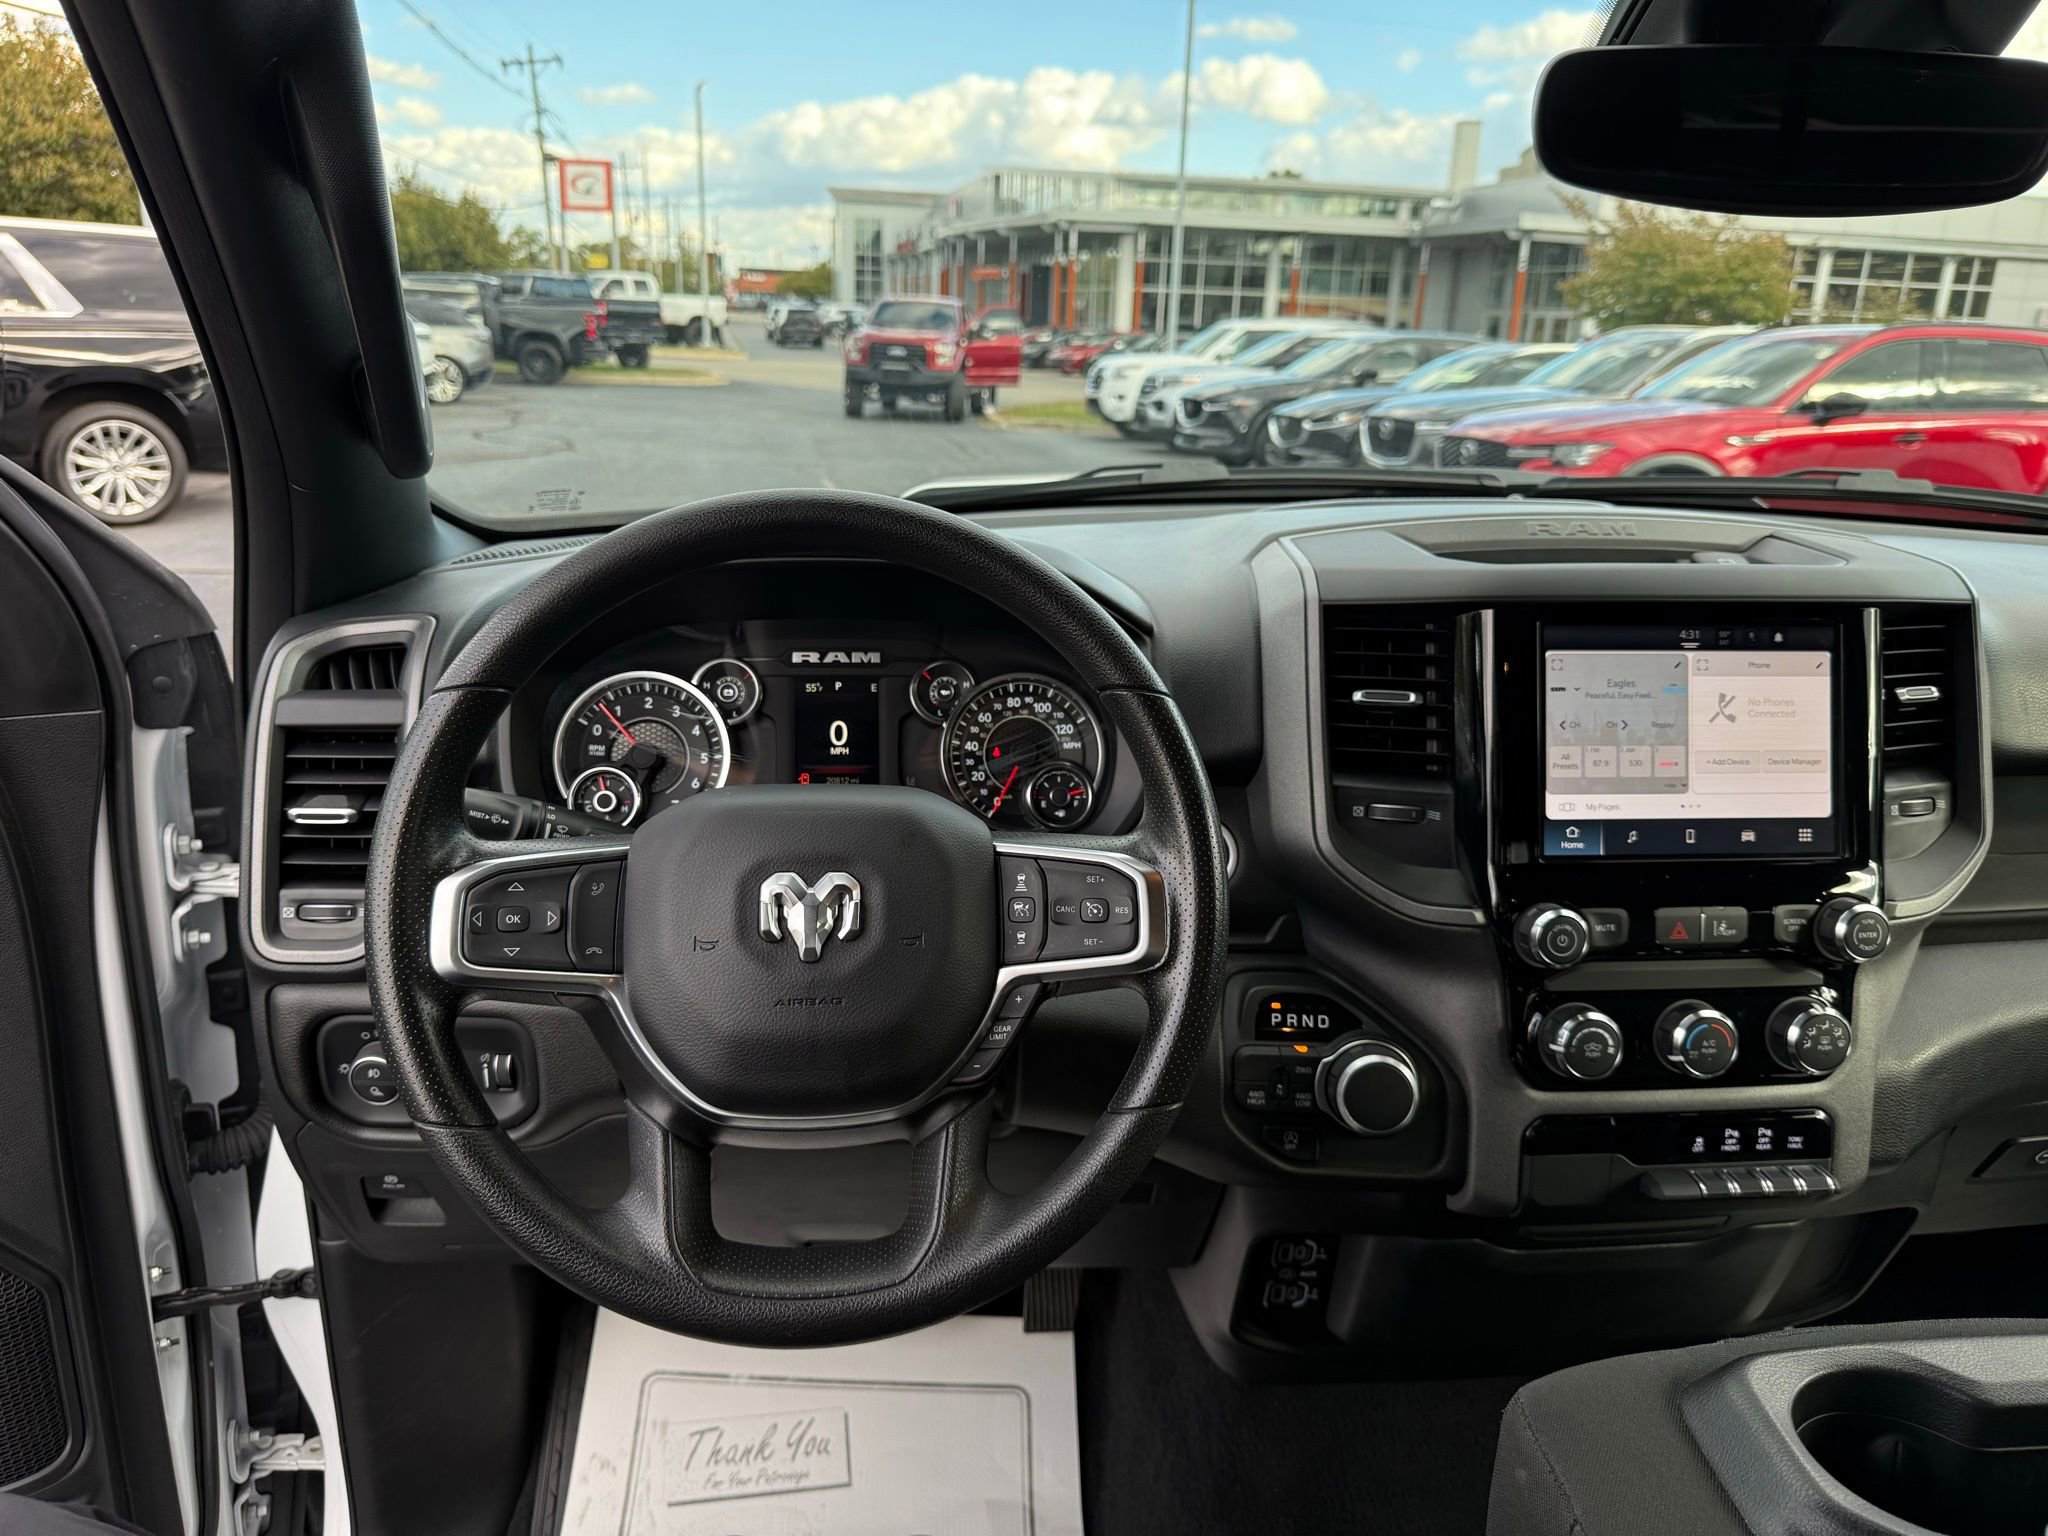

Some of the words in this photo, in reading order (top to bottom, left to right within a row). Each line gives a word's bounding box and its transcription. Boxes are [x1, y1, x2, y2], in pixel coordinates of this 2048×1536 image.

[1527, 521, 1637, 537] RAM
[1679, 630, 1700, 640] 4:31
[791, 651, 881, 663] RAM
[1748, 661, 1771, 669] Phone
[703, 681, 711, 689] H
[835, 681, 842, 691] P
[870, 683, 878, 692] E
[963, 681, 970, 689] H
[1606, 679, 1636, 689] Eagles
[643, 697, 653, 709] 2
[1006, 697, 1021, 708] 80
[1024, 696, 1034, 704] 90
[1748, 698, 1761, 706] No
[1763, 698, 1795, 706] Phones
[614, 705, 621, 717] 1
[672, 705, 681, 718] 3
[993, 703, 1002, 711] 70
[1033, 702, 1052, 713] 100
[937, 709, 943, 717] L
[977, 712, 992, 723] 60
[1748, 709, 1796, 718] Connected
[1055, 724, 1074, 735] 120
[1568, 721, 1581, 729] CH
[1606, 721, 1618, 729] CH
[1650, 721, 1675, 729] Replay
[592, 724, 602, 736] 0
[692, 724, 701, 737] 4
[829, 720, 848, 746] 0
[964, 741, 979, 751] 40
[1063, 741, 1082, 749] MPH
[830, 747, 849, 755] MPH
[700, 752, 709, 764] 5
[965, 758, 975, 766] 30
[1791, 758, 1822, 767] Manager
[1552, 762, 1579, 770] Presets
[971, 771, 985, 781] 20
[691, 777, 700, 789] 6
[979, 788, 988, 796] 10
[993, 796, 1001, 807] 0
[1040, 801, 1046, 809] E
[585, 804, 592, 813] C
[621, 804, 629, 813] H
[1585, 803, 1597, 812] My
[1598, 803, 1620, 811] Pages
[469, 809, 486, 819] MIST
[1561, 841, 1585, 849] Home
[1055, 905, 1076, 913] CANC
[1115, 906, 1129, 914] RES
[505, 914, 521, 924] OK
[1595, 924, 1616, 932] MUTE
[774, 997, 844, 1007] AIRBAG
[993, 1025, 1012, 1033] GEAR
[989, 1033, 1008, 1041] LIMIT
[1247, 1090, 1265, 1098] 4WD
[1295, 1099, 1312, 1108] LOW
[684, 1422, 779, 1472] Thank
[786, 1416, 832, 1462] You
[703, 1472, 724, 1490] For
[728, 1470, 753, 1488] Your
